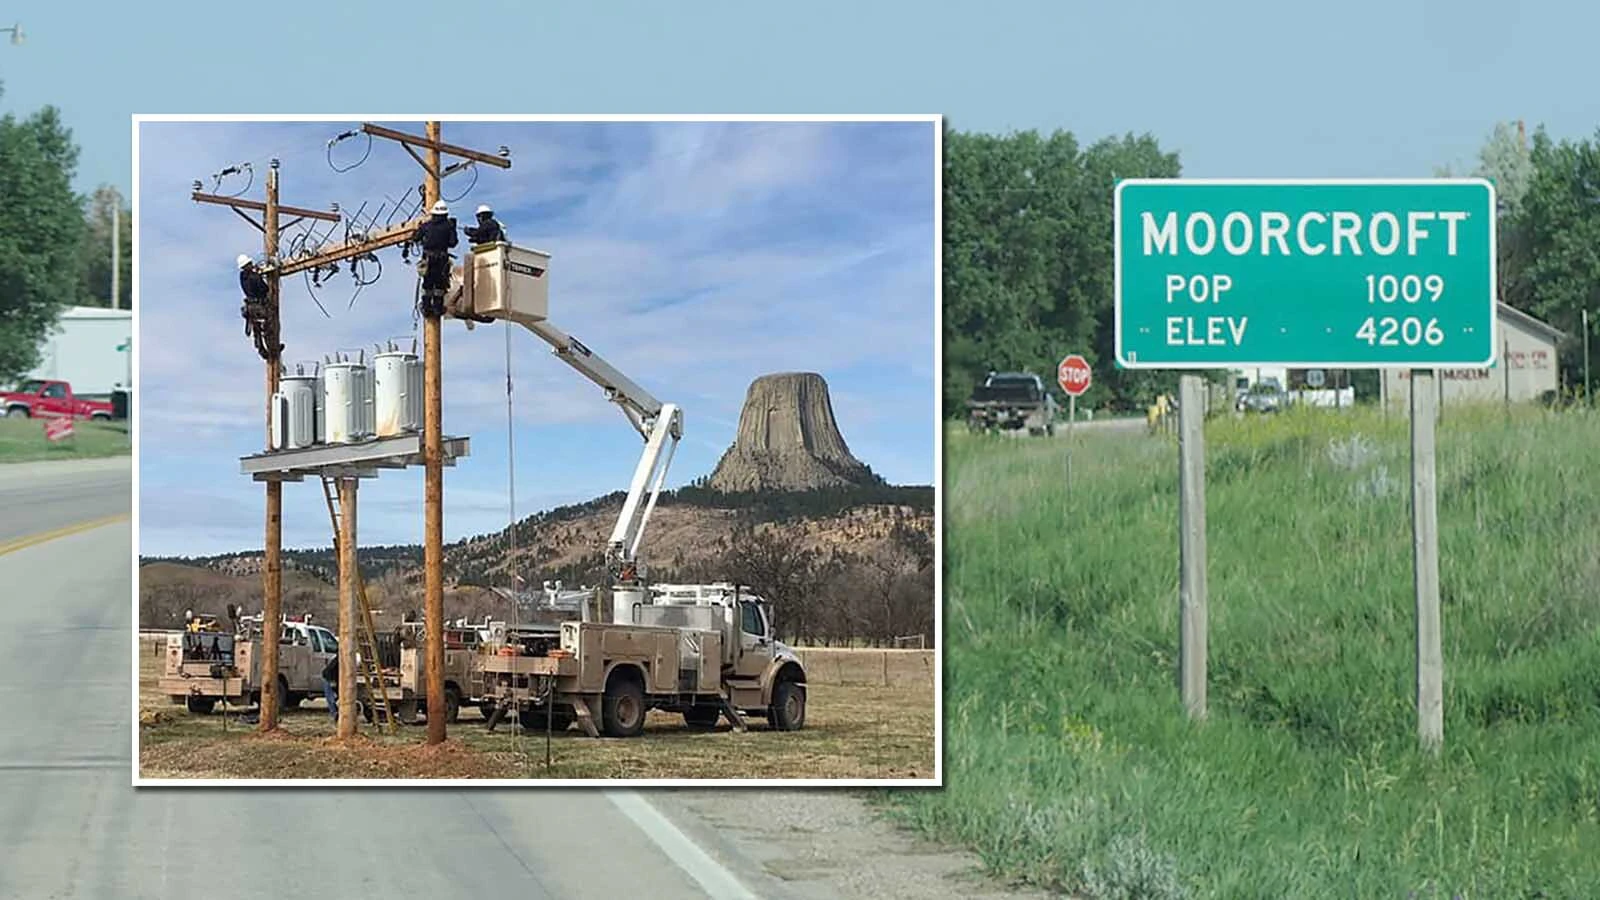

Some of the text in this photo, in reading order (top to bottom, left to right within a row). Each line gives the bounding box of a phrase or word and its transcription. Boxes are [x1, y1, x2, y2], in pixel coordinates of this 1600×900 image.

[1142, 211, 1469, 256] MOORCROFT
[1166, 274, 1444, 303] POP 1009
[1166, 316, 1444, 346] ELEV 4206
[1060, 366, 1089, 384] STOP
[1443, 368, 1490, 380] MUSEUM
